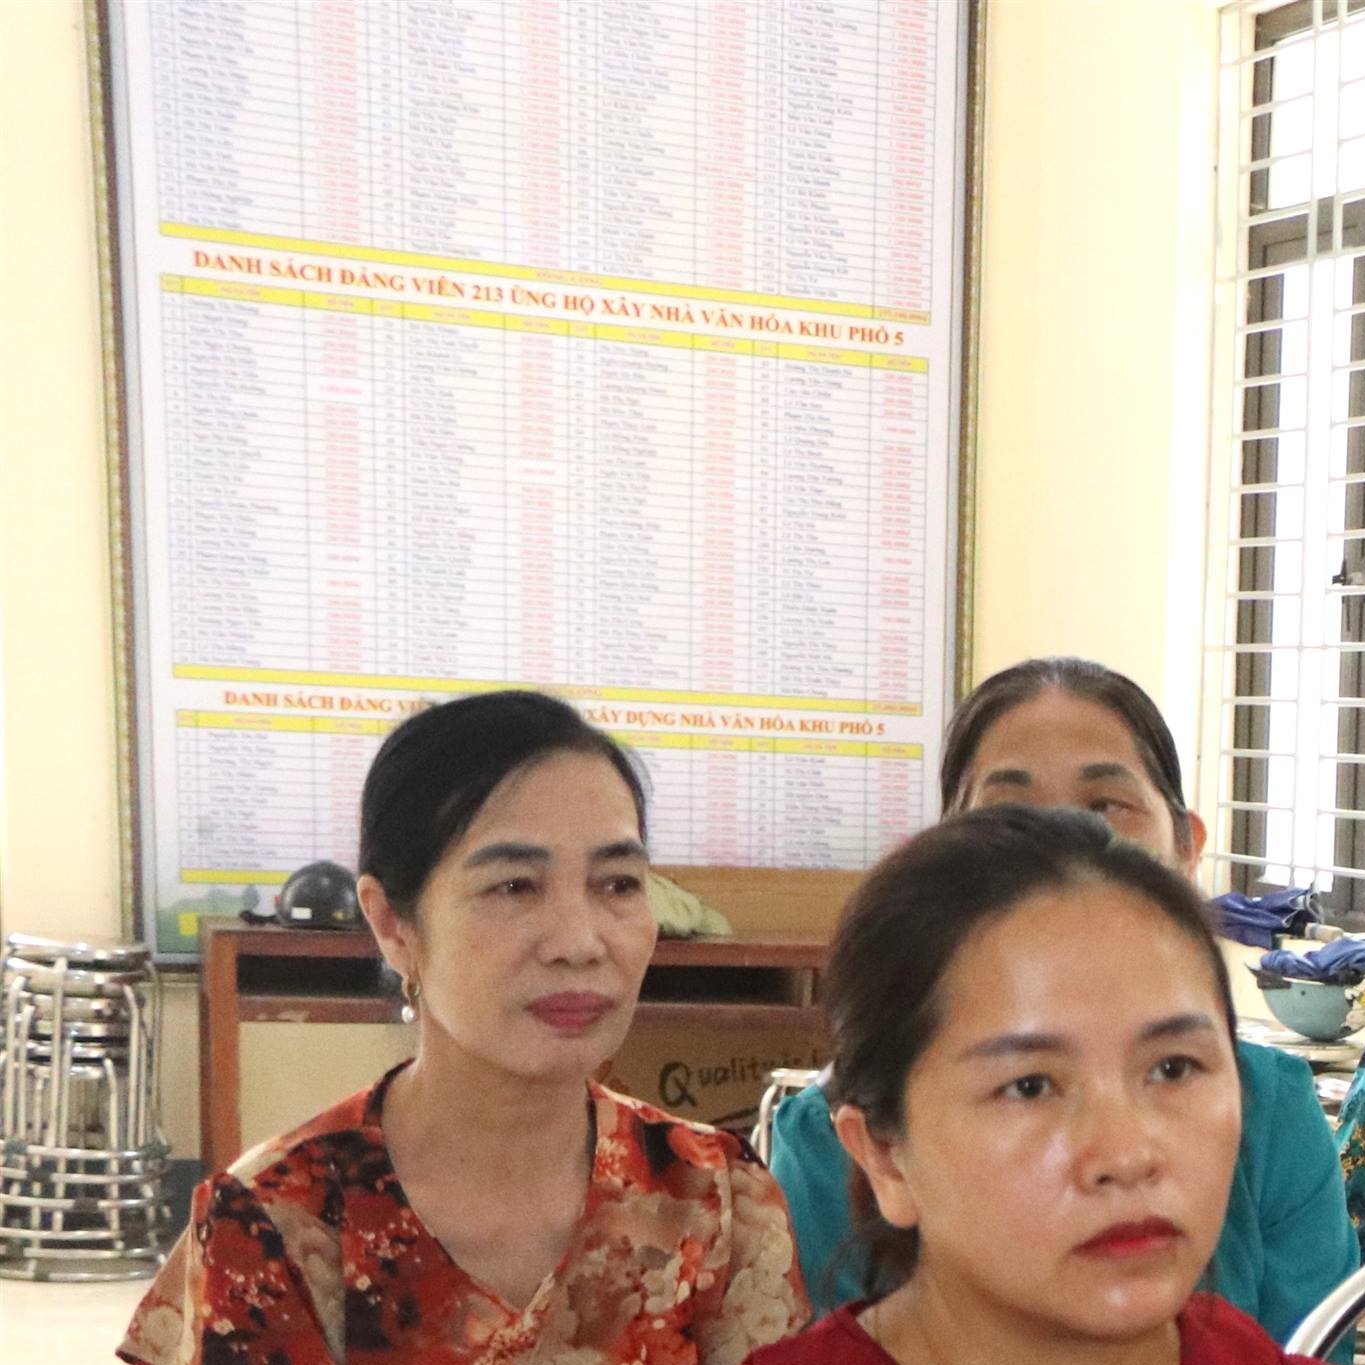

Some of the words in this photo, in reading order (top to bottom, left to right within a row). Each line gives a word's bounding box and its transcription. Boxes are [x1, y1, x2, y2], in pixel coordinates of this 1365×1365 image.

[193, 250, 262, 275] DANH
[269, 257, 333, 283] SÁCH
[339, 266, 405, 292] ĐẢNG
[411, 275, 465, 297] VIÊN
[472, 284, 504, 302] 213
[510, 284, 557, 309] ỦNG
[563, 294, 595, 316] HỘ
[601, 296, 645, 318] XÂY
[651, 302, 695, 324] NHÀ
[701, 308, 744, 328] VĂN
[750, 312, 794, 334] HÓA
[799, 320, 842, 339] KHU
[849, 325, 890, 345] PHỐ
[894, 330, 905, 346] 5
[223, 690, 279, 707] DANH
[283, 690, 335, 710] SÁCH
[800, 718, 836, 733] KHU
[876, 722, 887, 736] 5
